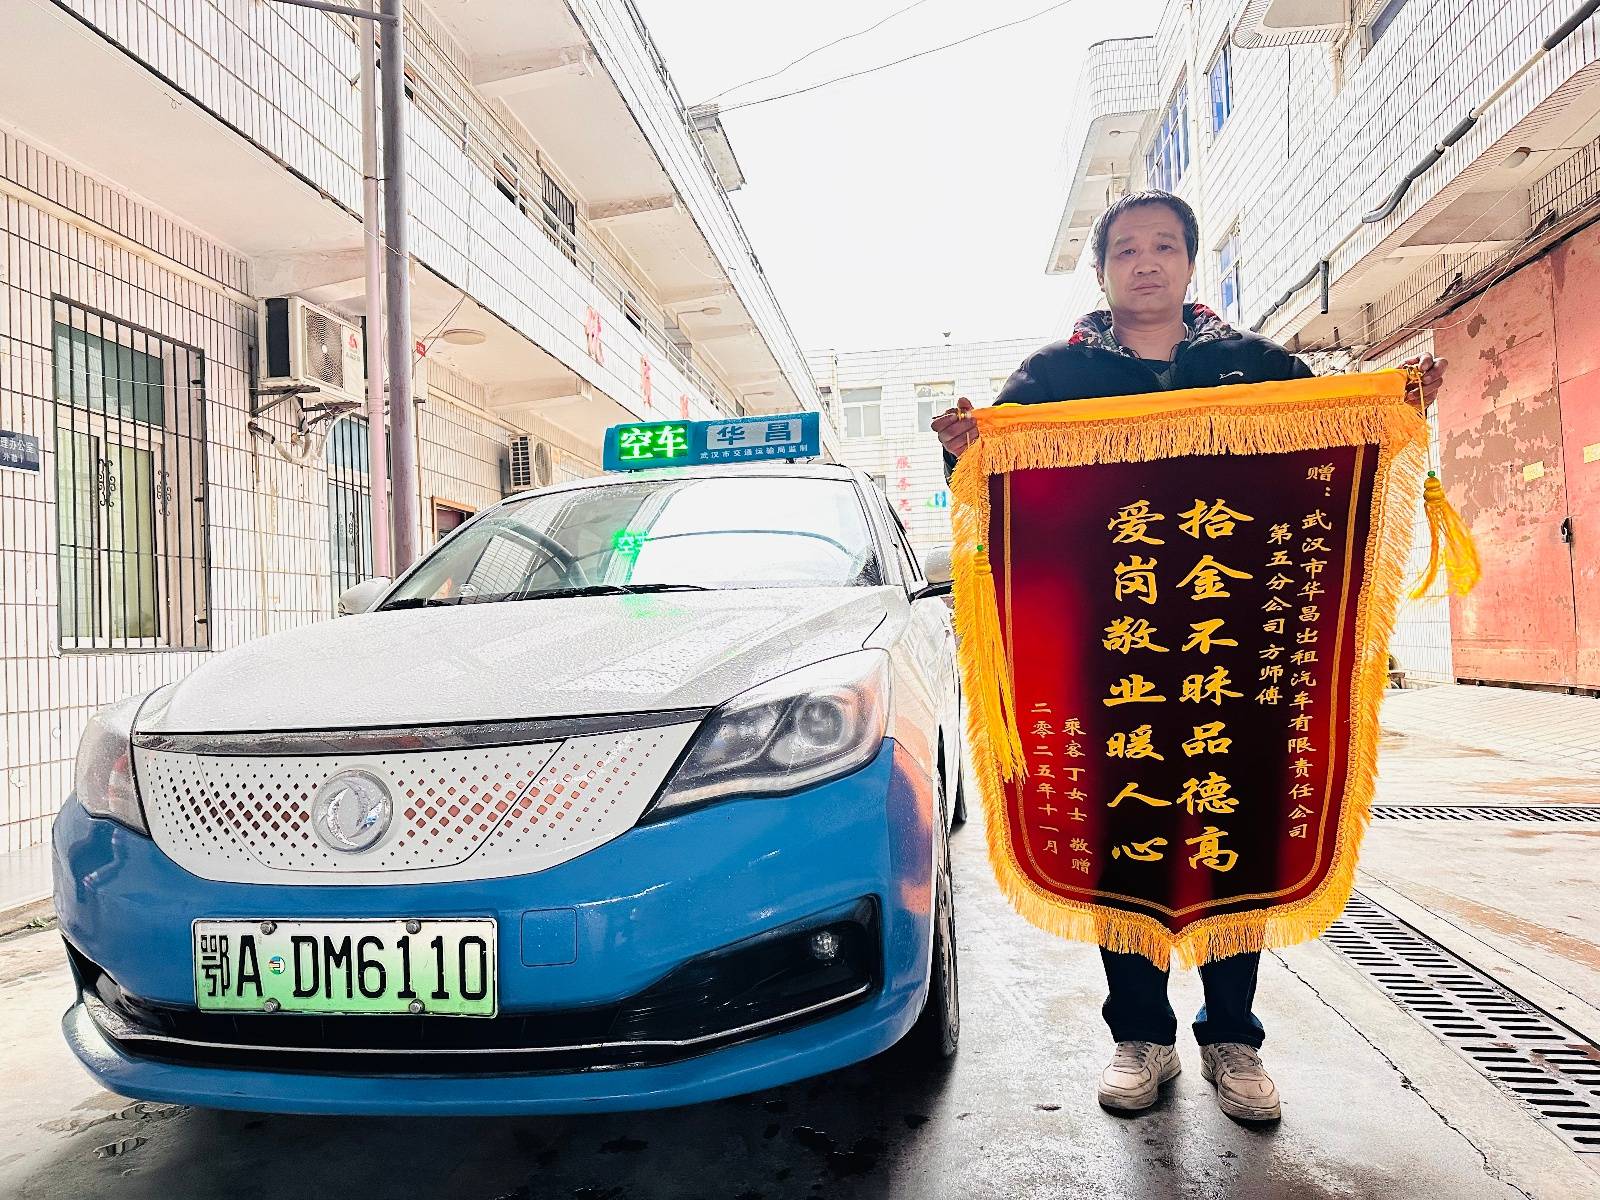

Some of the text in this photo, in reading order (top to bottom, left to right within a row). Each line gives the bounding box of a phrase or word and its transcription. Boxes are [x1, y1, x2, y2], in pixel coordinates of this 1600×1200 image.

[620, 425, 688, 460] 空车
[700, 443, 808, 460] 武汉市交通运输局监制
[716, 421, 791, 446] 华昌
[1101, 499, 1173, 862] 爱岗敬业暖人心
[1175, 498, 1255, 872] 拾金不昧品德高
[1029, 702, 1060, 855] 二零二五年十一月
